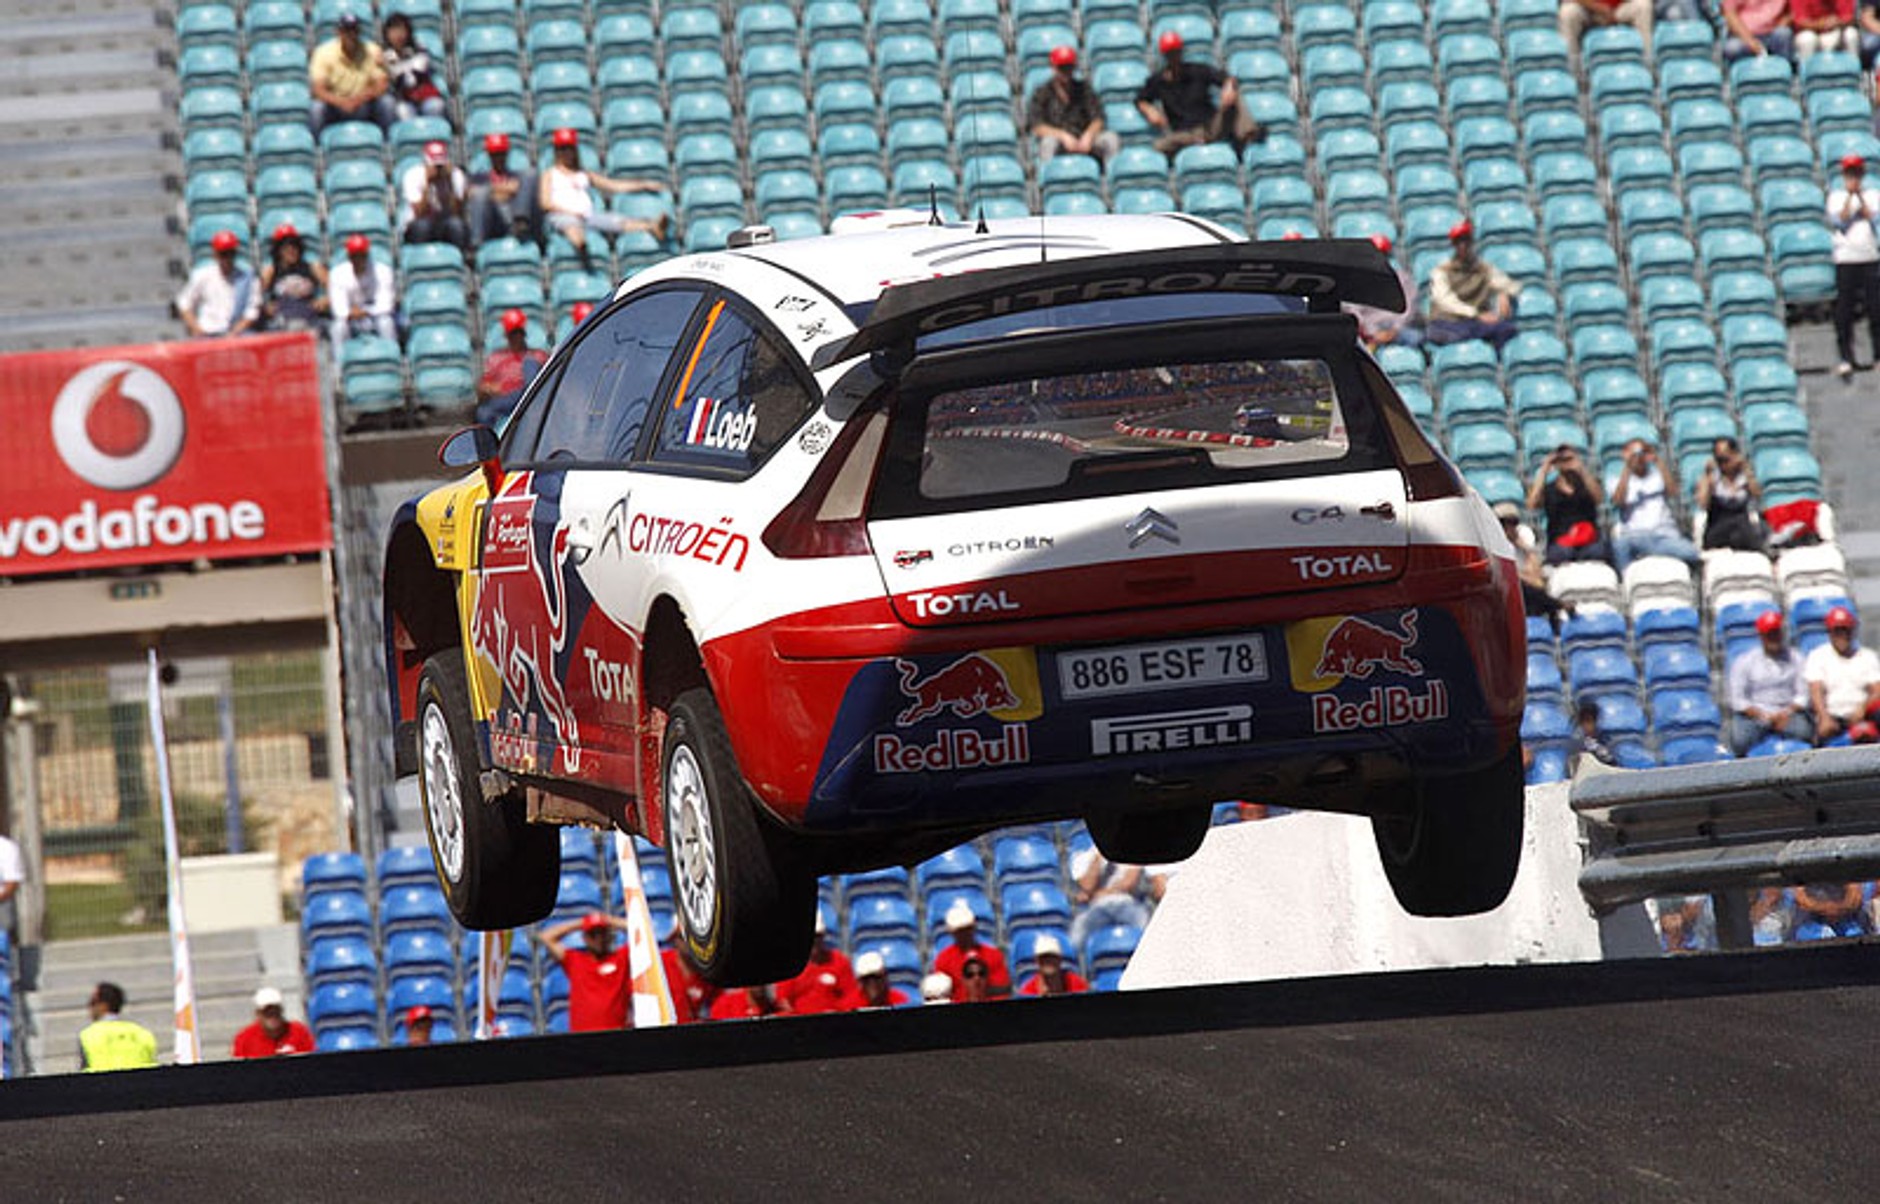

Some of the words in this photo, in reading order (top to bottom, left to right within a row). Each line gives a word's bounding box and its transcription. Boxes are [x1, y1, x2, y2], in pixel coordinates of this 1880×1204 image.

[918, 262, 1337, 332] CITROËN
[703, 400, 758, 452] Loeb
[1290, 505, 1346, 526] C4
[628, 511, 750, 573] CITROËN
[1290, 552, 1393, 580] TOTAL
[906, 589, 1020, 619] TOTAL
[1071, 656, 1129, 690] 886
[1139, 647, 1205, 682] ESF
[1216, 643, 1254, 674] 78
[1091, 704, 1254, 756] PIRELLI
[1312, 686, 1383, 733] Red
[1384, 679, 1449, 726] Bull
[875, 729, 952, 773] Red
[952, 723, 1030, 769] Bull
